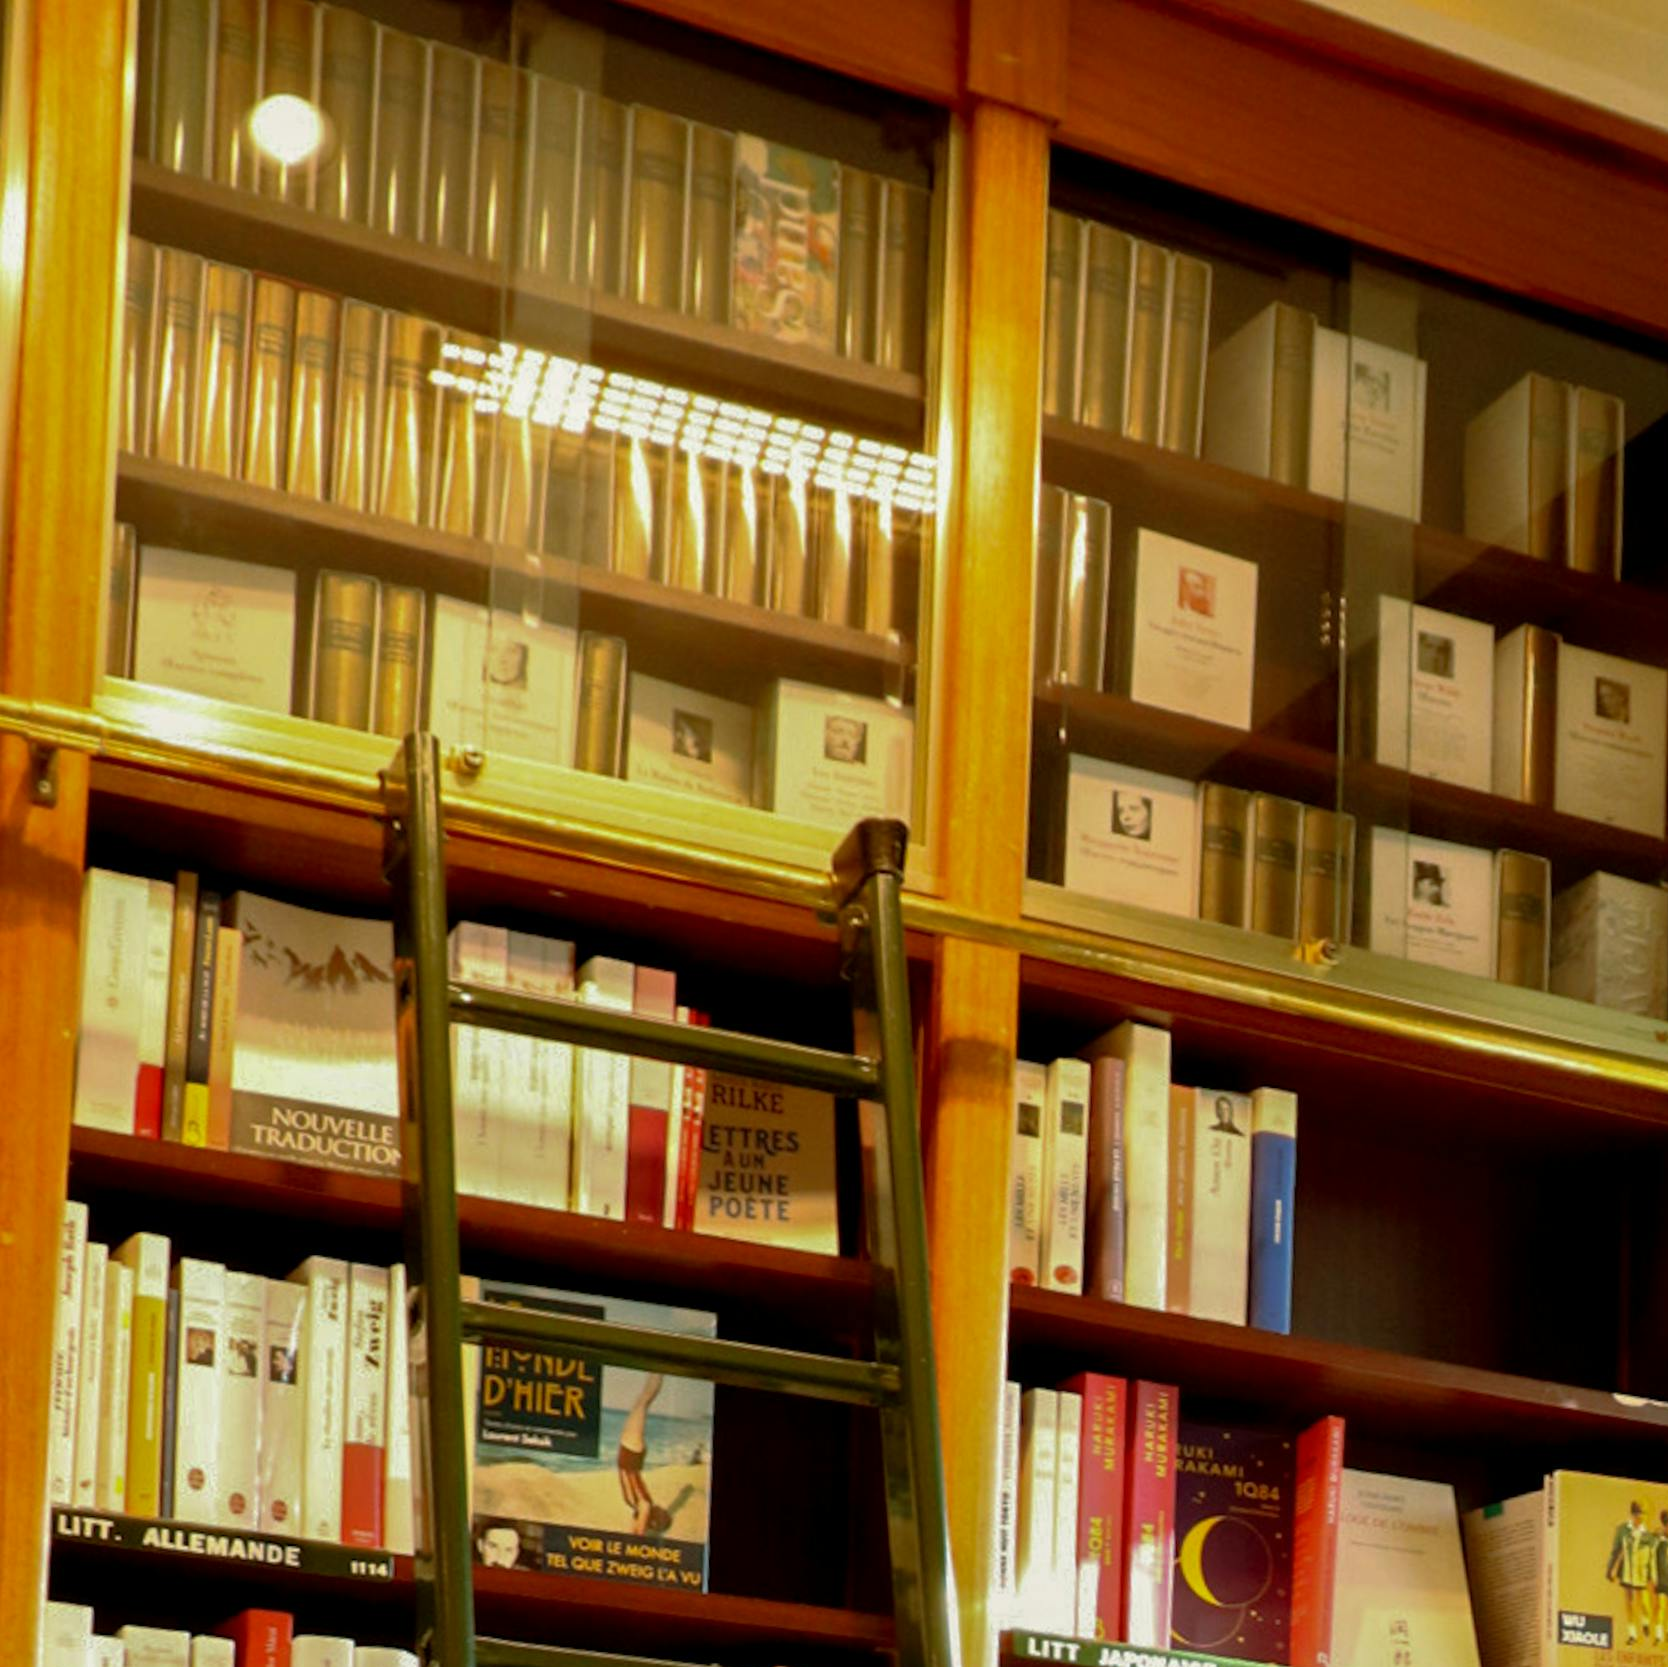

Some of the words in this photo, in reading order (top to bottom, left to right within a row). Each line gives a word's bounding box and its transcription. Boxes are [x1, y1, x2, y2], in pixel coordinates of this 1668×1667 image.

[712, 1084, 785, 1114] RILKE
[271, 1106, 393, 1145] NOUVELLE
[709, 1171, 790, 1196] JEUNE
[483, 1374, 586, 1420] D'HIER
[1176, 1443, 1214, 1460] RUKI
[1176, 1458, 1245, 1479] RAKAMI
[1234, 1480, 1280, 1501] 1Q84
[57, 1514, 122, 1542] LITT.
[142, 1526, 301, 1568] ALLEMANDE
[626, 1542, 682, 1563] MONDE
[1027, 1636, 1080, 1662] LITT
